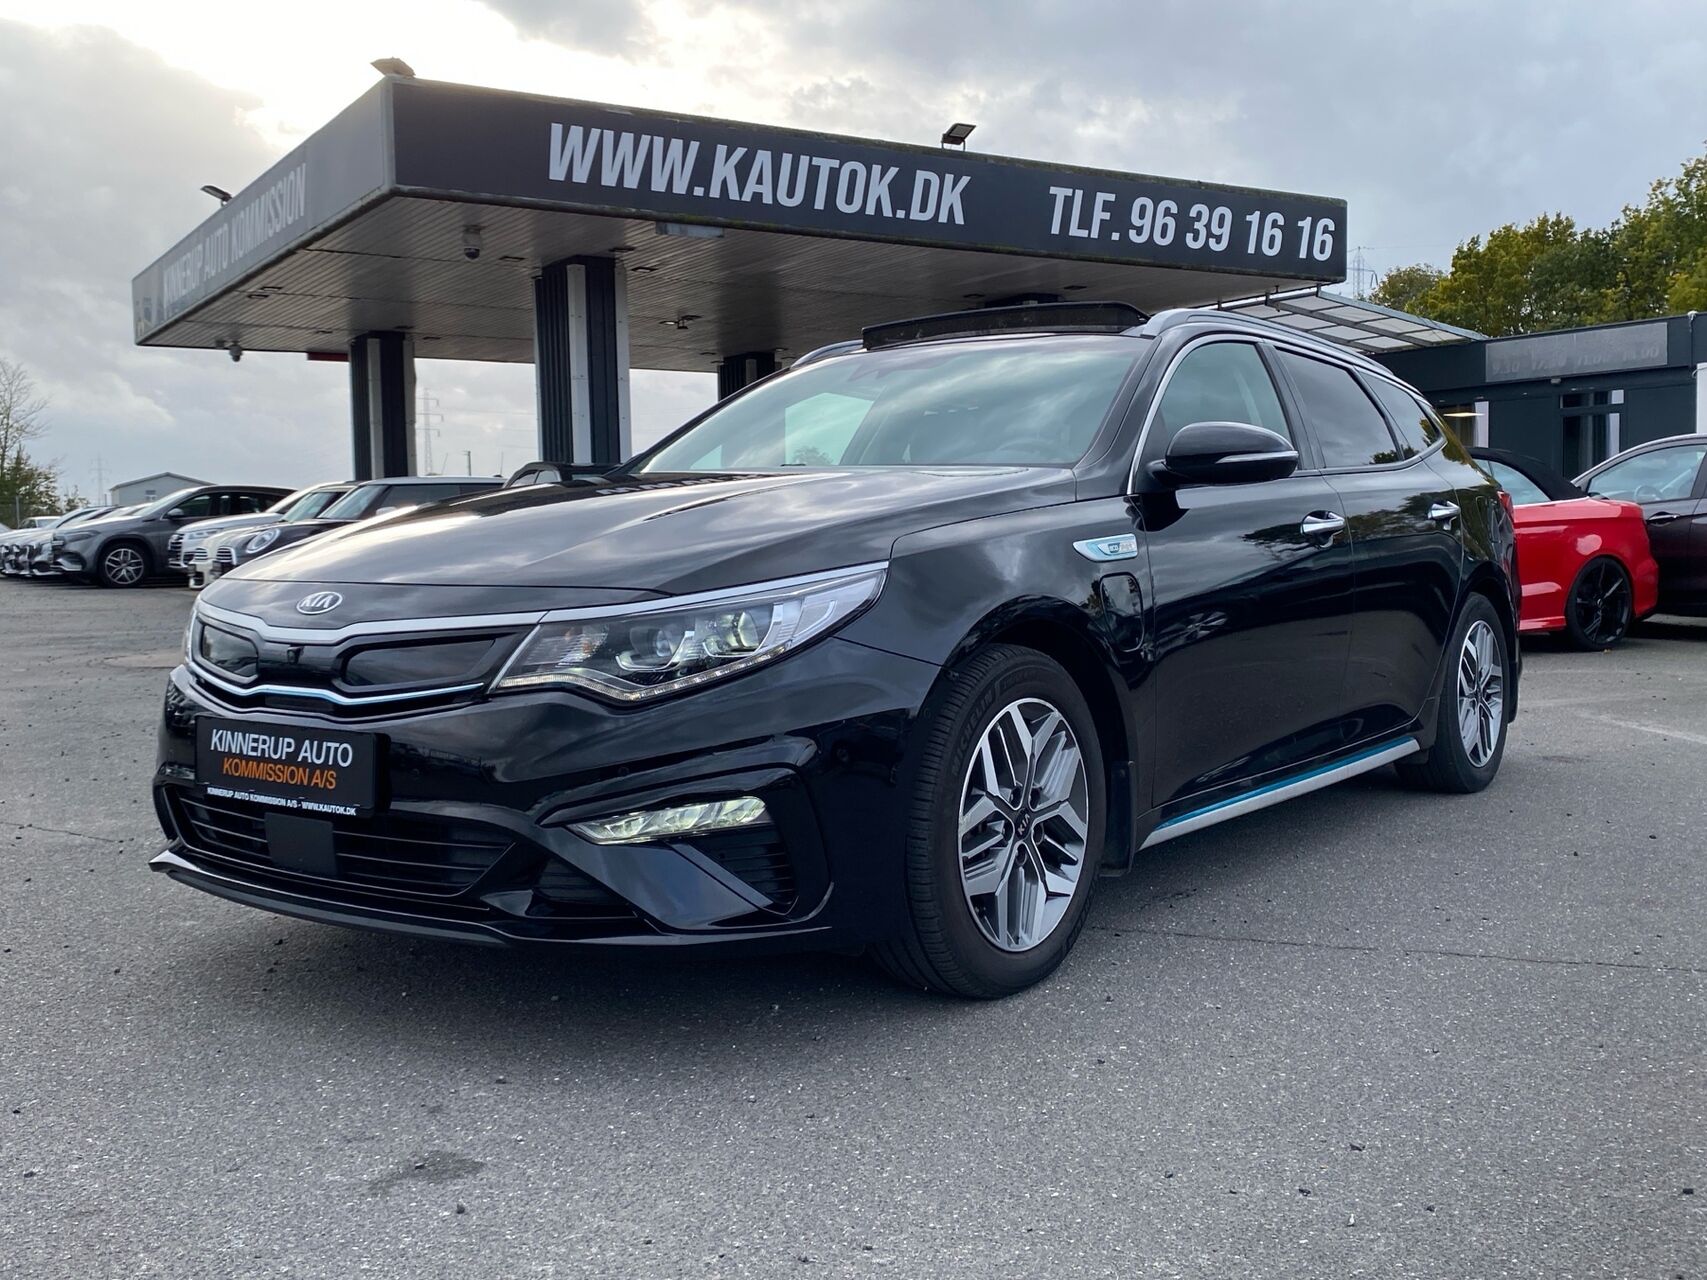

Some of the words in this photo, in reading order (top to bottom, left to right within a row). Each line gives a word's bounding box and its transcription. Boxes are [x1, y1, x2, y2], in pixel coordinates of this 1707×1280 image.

[548, 122, 972, 225] WWW.KAUTOK.DK
[203, 222, 230, 281] AUTO
[231, 163, 306, 263] KOMMISSION
[1048, 186, 1121, 241] TLF.
[1128, 196, 1179, 246] 96
[1185, 203, 1233, 252] 39
[1245, 210, 1286, 257] 16
[1297, 216, 1336, 262] 16
[299, 593, 335, 609] KIA
[210, 728, 295, 760] KINNERUP
[297, 739, 353, 767] AUTO
[222, 757, 309, 787] KOMMISSION
[311, 768, 337, 790] A/S
[234, 790, 250, 801] AUTO
[1017, 813, 1031, 836] KIA
